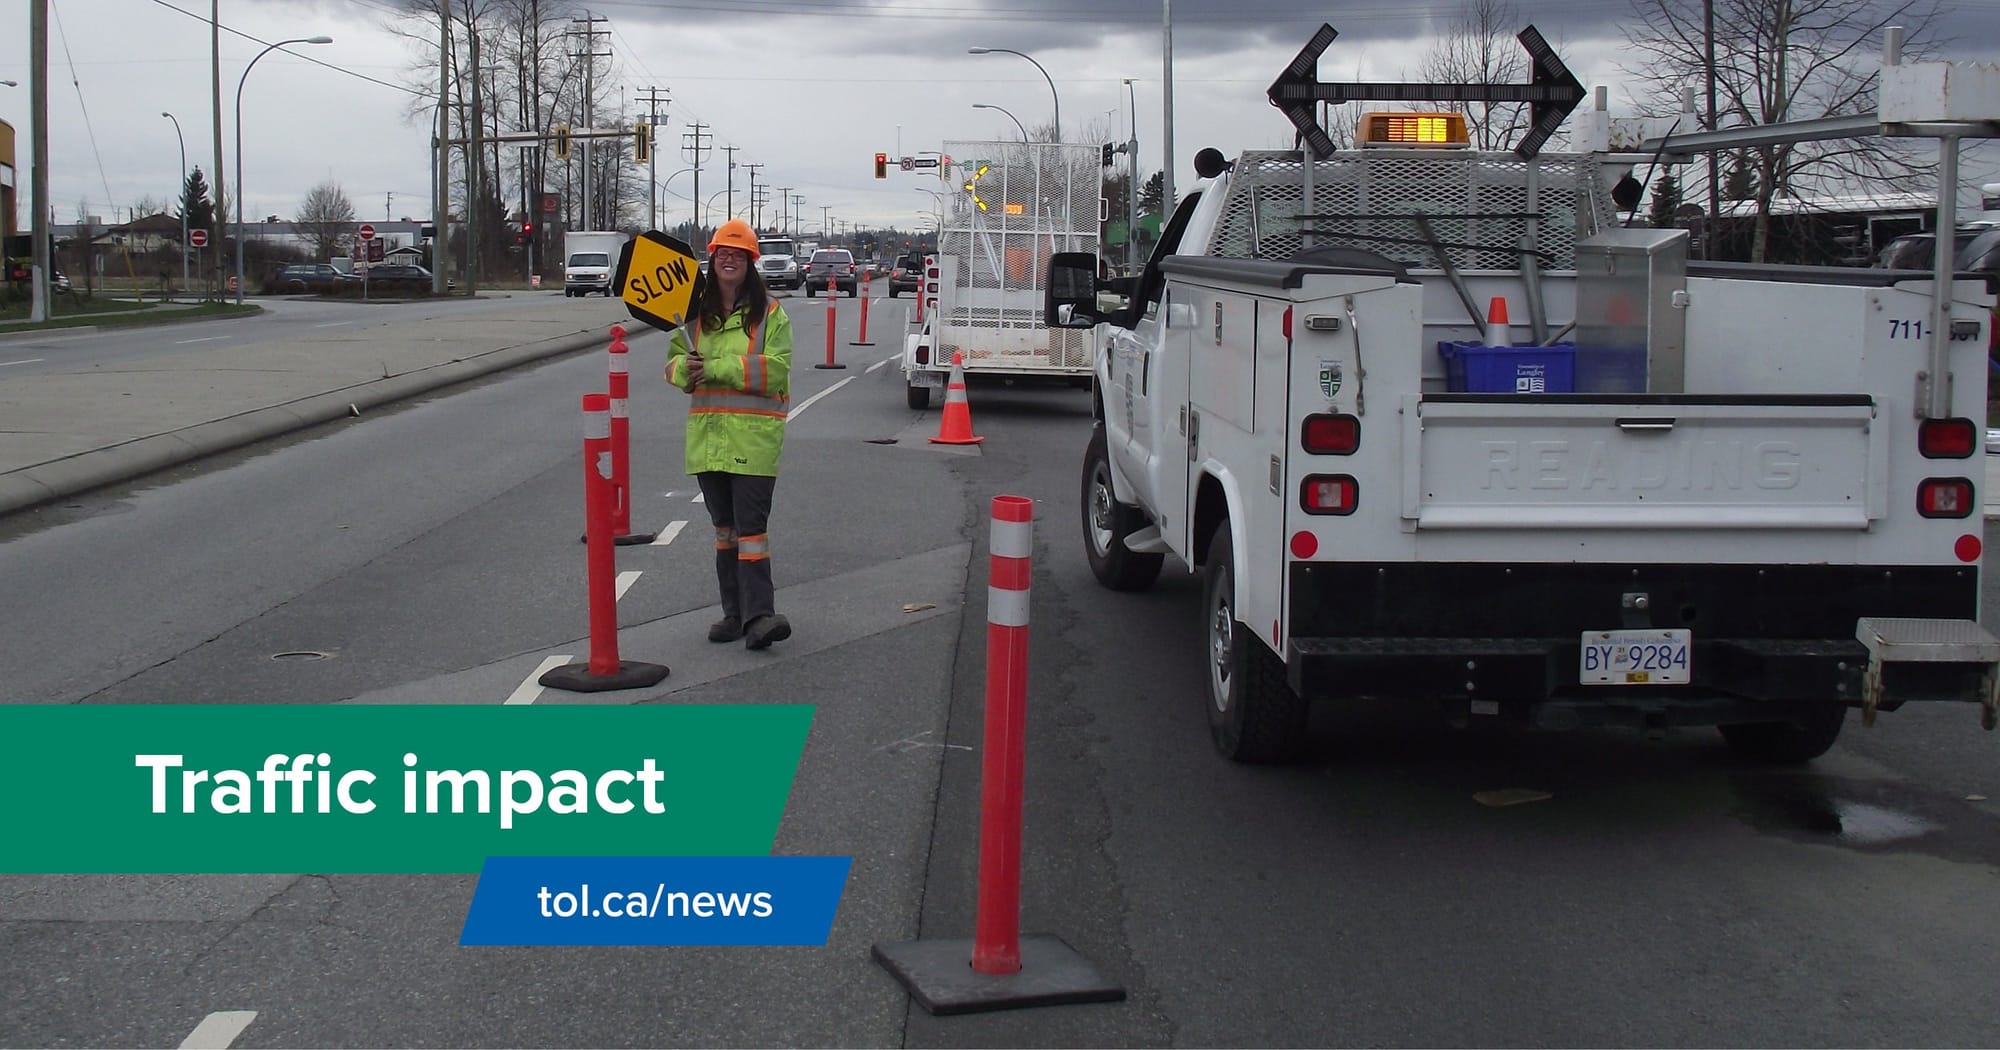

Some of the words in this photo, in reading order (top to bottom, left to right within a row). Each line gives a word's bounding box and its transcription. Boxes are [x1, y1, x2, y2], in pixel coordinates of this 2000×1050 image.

[630, 257, 690, 304] SLOW
[1479, 441, 1800, 490] READING
[1585, 645, 1613, 671] BY
[1628, 645, 1687, 671] 9284
